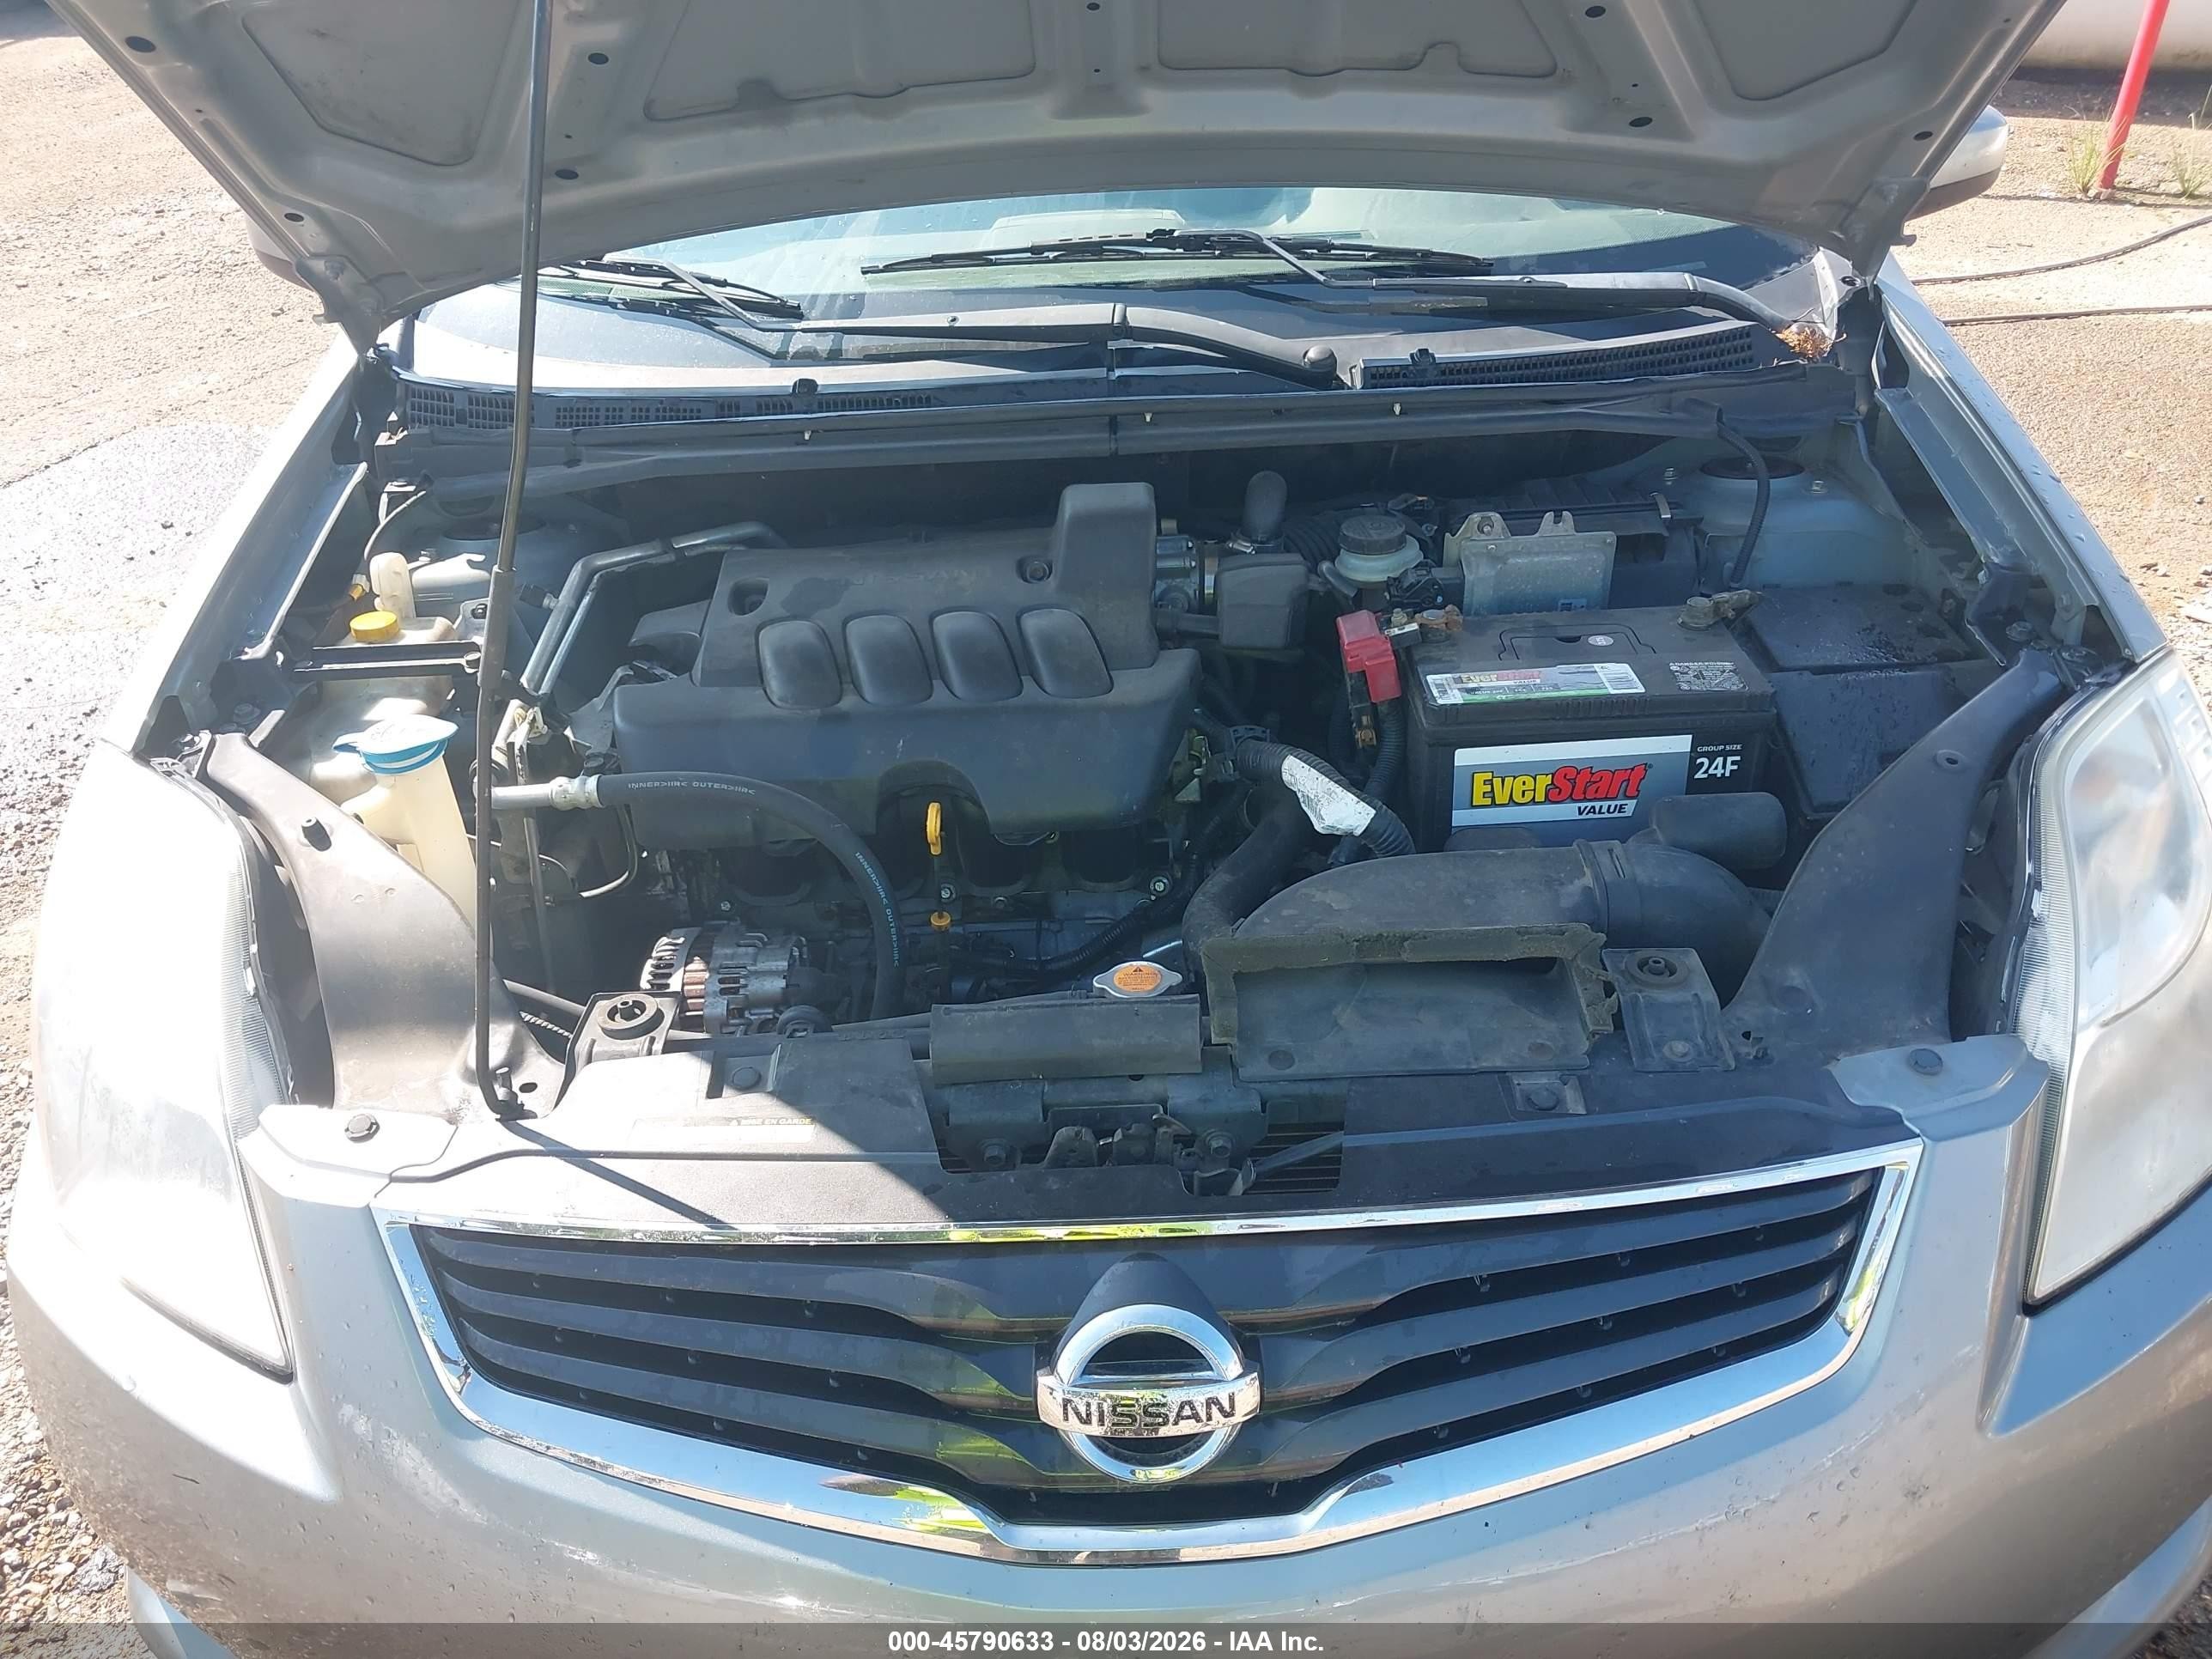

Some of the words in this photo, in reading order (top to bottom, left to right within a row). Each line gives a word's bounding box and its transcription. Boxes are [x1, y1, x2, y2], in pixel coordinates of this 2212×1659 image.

[1693, 755, 1741, 780] 24F
[1471, 762, 1649, 808] EverStart
[1577, 803, 1628, 817] VALUE
[1061, 1391, 1236, 1429] NISSAN
